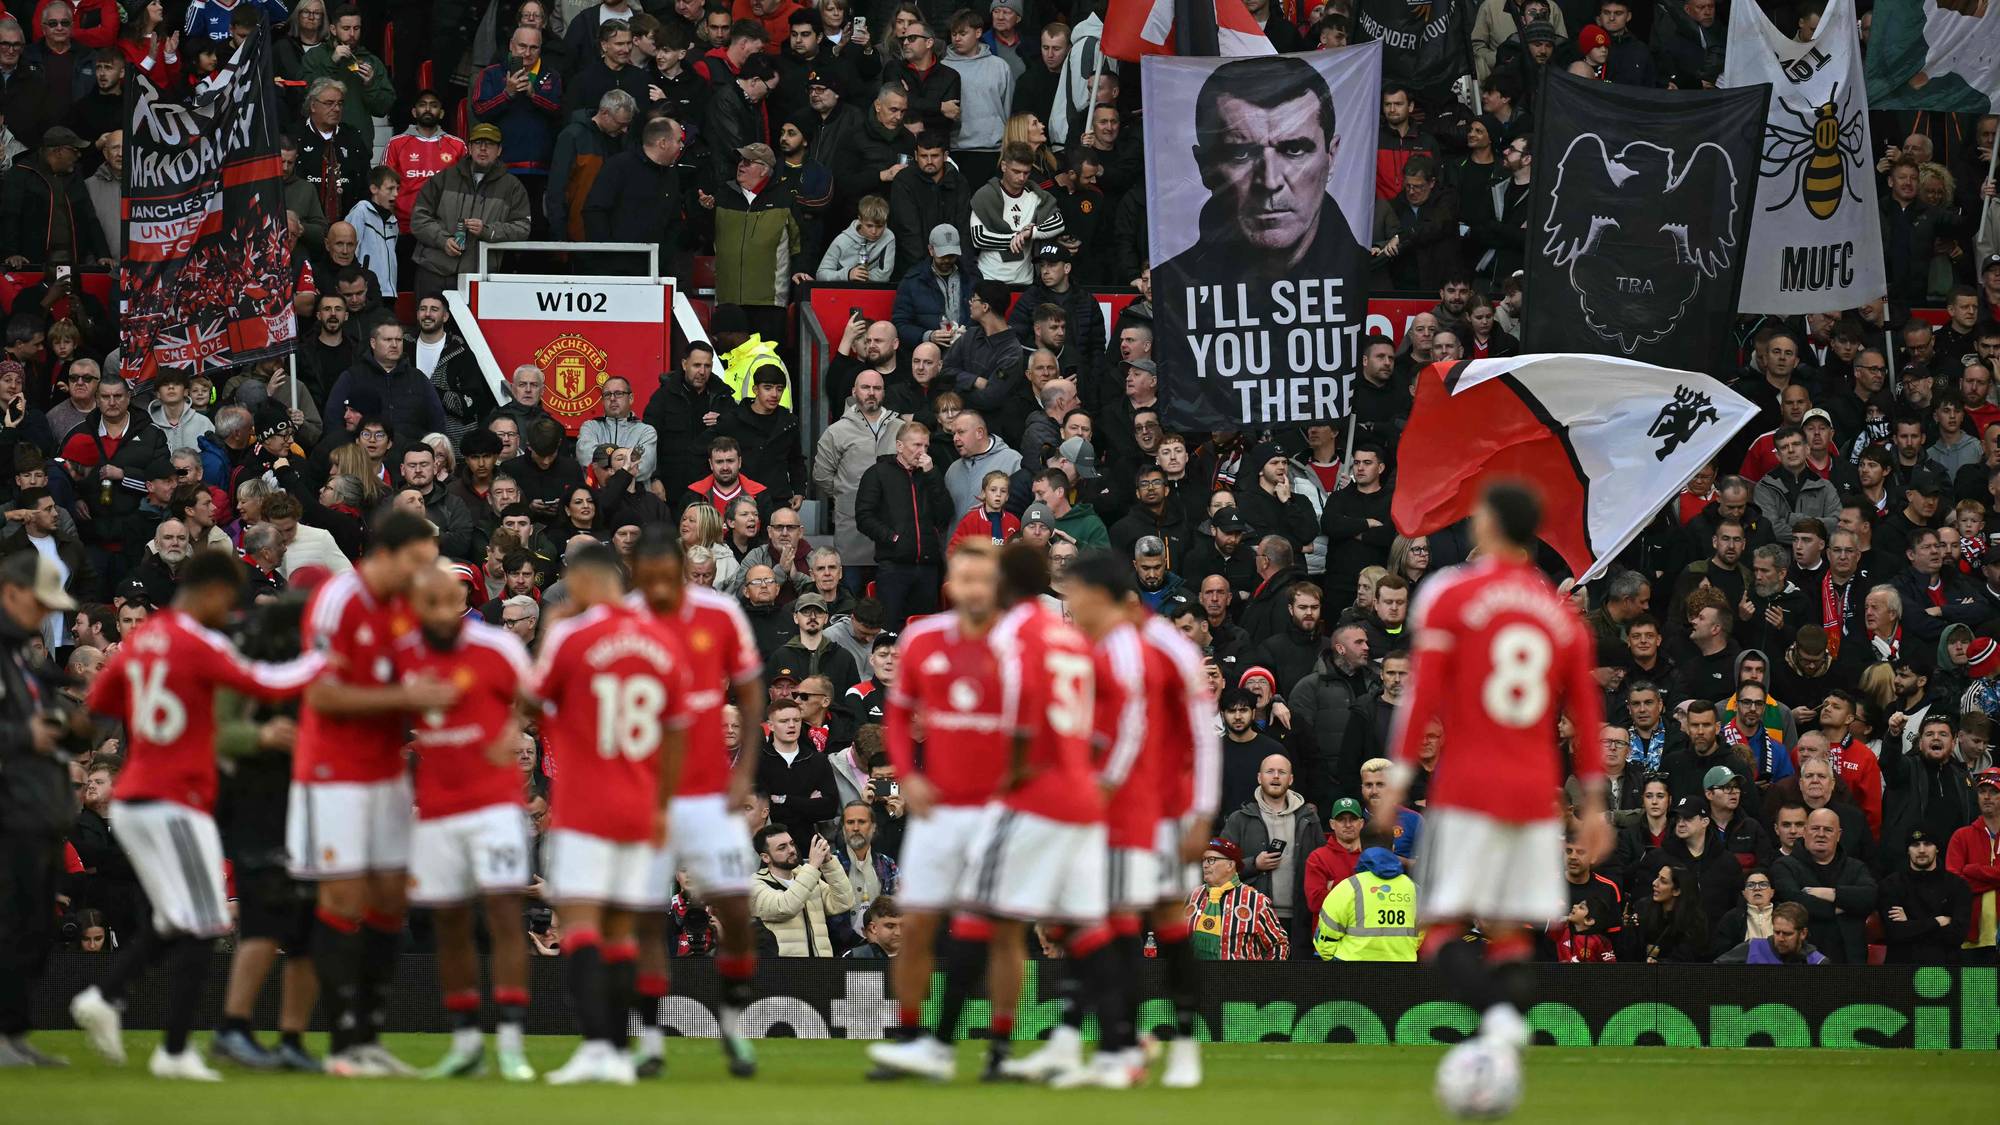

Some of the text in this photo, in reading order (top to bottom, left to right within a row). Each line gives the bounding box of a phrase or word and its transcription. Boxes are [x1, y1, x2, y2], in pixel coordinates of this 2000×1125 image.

[161, 239, 191, 256] FC
[1780, 241, 1854, 292] MUFC
[1616, 276, 1655, 295] TRA
[536, 291, 607, 313] W102
[1186, 277, 1346, 330] I'LL SEE
[162, 336, 224, 362] ONE LOVE
[540, 339, 602, 366] MANCHESTER
[1187, 331, 1272, 378] YOU
[1287, 323, 1361, 374] OUT
[549, 396, 593, 411] UNITED
[1233, 372, 1357, 424] THERE
[1481, 622, 1554, 730] 8
[123, 657, 188, 746] 16
[592, 673, 668, 762] 18
[1388, 892, 1411, 903] CSG
[1378, 909, 1406, 925] 308
